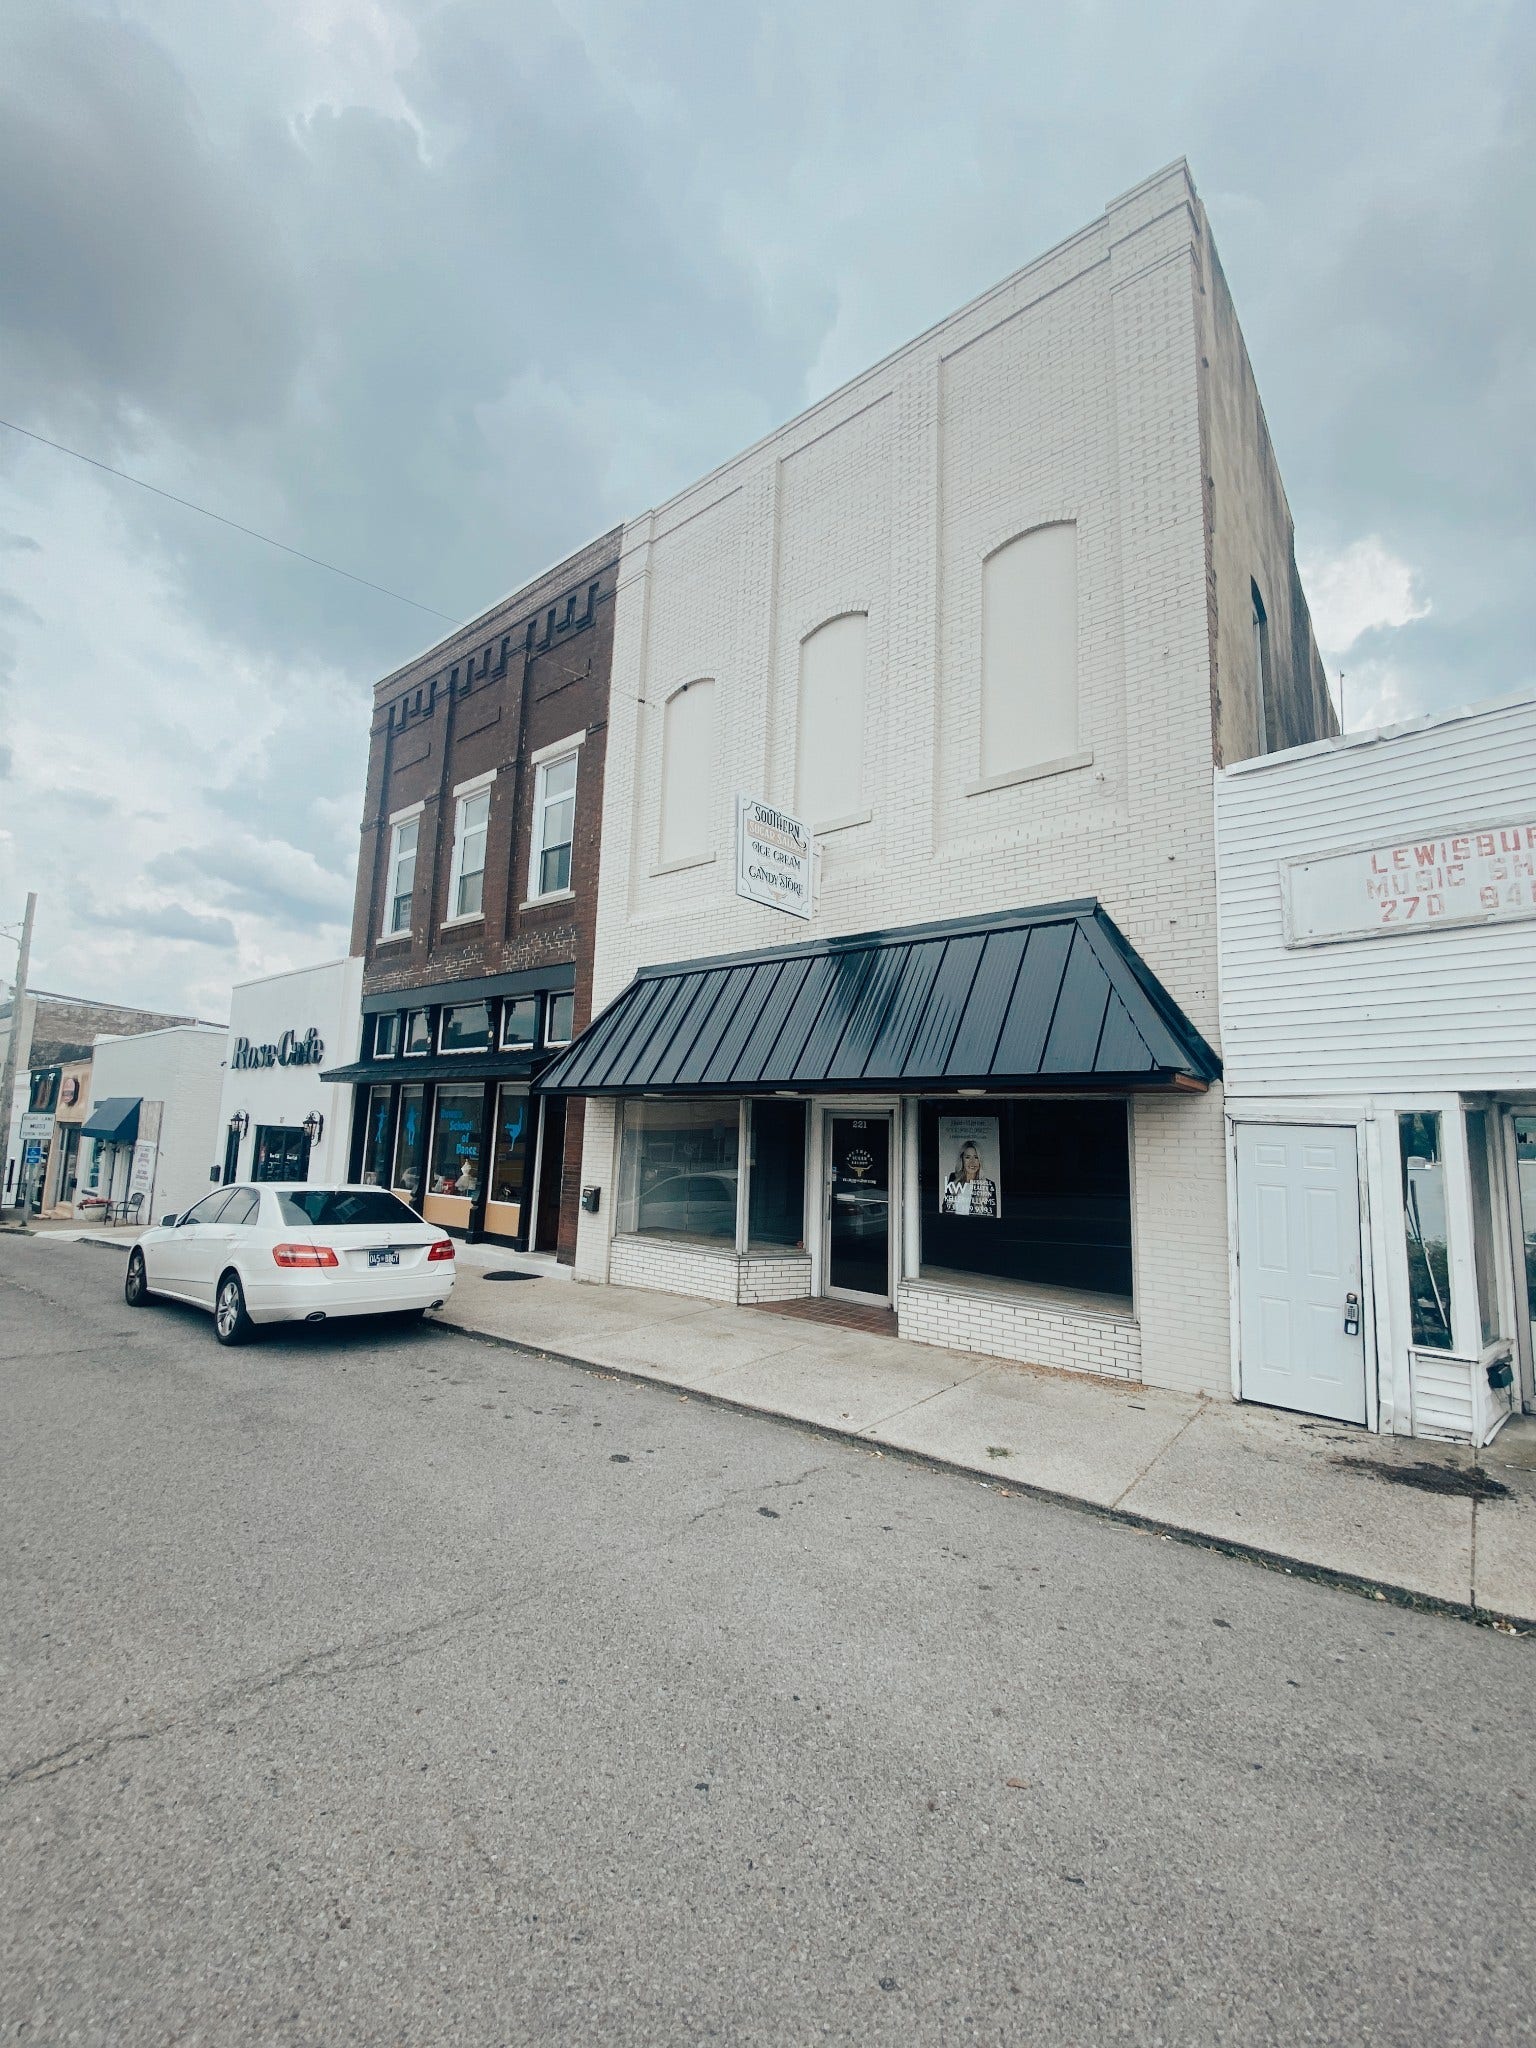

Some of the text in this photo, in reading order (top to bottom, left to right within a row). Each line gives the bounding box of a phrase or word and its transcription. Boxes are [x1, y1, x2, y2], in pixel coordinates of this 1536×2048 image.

[749, 821, 775, 840] SUGAR
[755, 806, 806, 848] SOUTHERN
[773, 850, 801, 869] CREAM
[749, 865, 804, 896] CANDY STORE
[1366, 863, 1466, 899] MUSIC
[1379, 894, 1445, 923] 270
[230, 1036, 278, 1069] Rose
[449, 1120, 473, 1131] School
[852, 1120, 868, 1129] 221
[461, 1132, 470, 1143] of
[455, 1143, 477, 1155] Dance
[944, 1176, 969, 1194] kw
